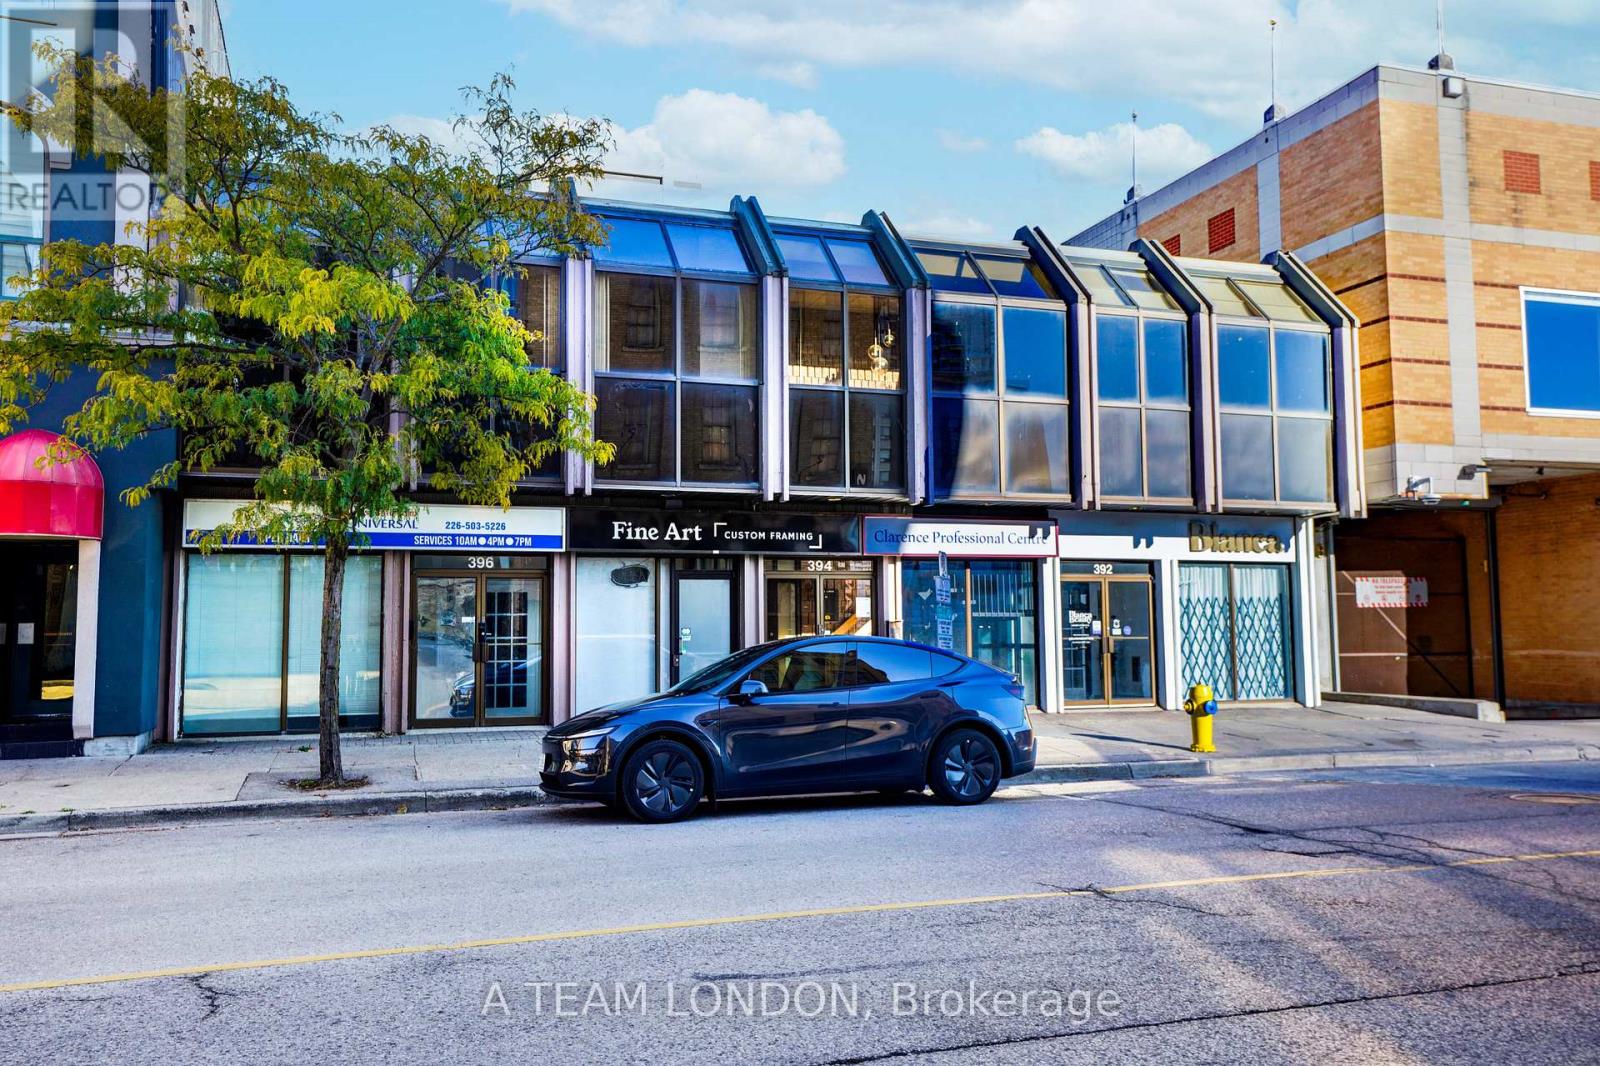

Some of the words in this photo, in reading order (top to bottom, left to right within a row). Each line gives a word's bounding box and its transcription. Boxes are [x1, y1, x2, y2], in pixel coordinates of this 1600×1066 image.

[445, 521, 506, 531] 226-503-5226
[612, 521, 659, 540] Fine
[664, 521, 702, 541] Art
[414, 535, 453, 546] SERVICES
[724, 530, 766, 540] CUSTOM
[770, 531, 813, 541] FRAMING
[874, 528, 929, 543] Clarence
[932, 530, 1005, 545] Professional
[1008, 532, 1047, 545] Centre
[467, 556, 495, 569] 396
[807, 560, 833, 572] 394
[1093, 563, 1114, 575] 392
